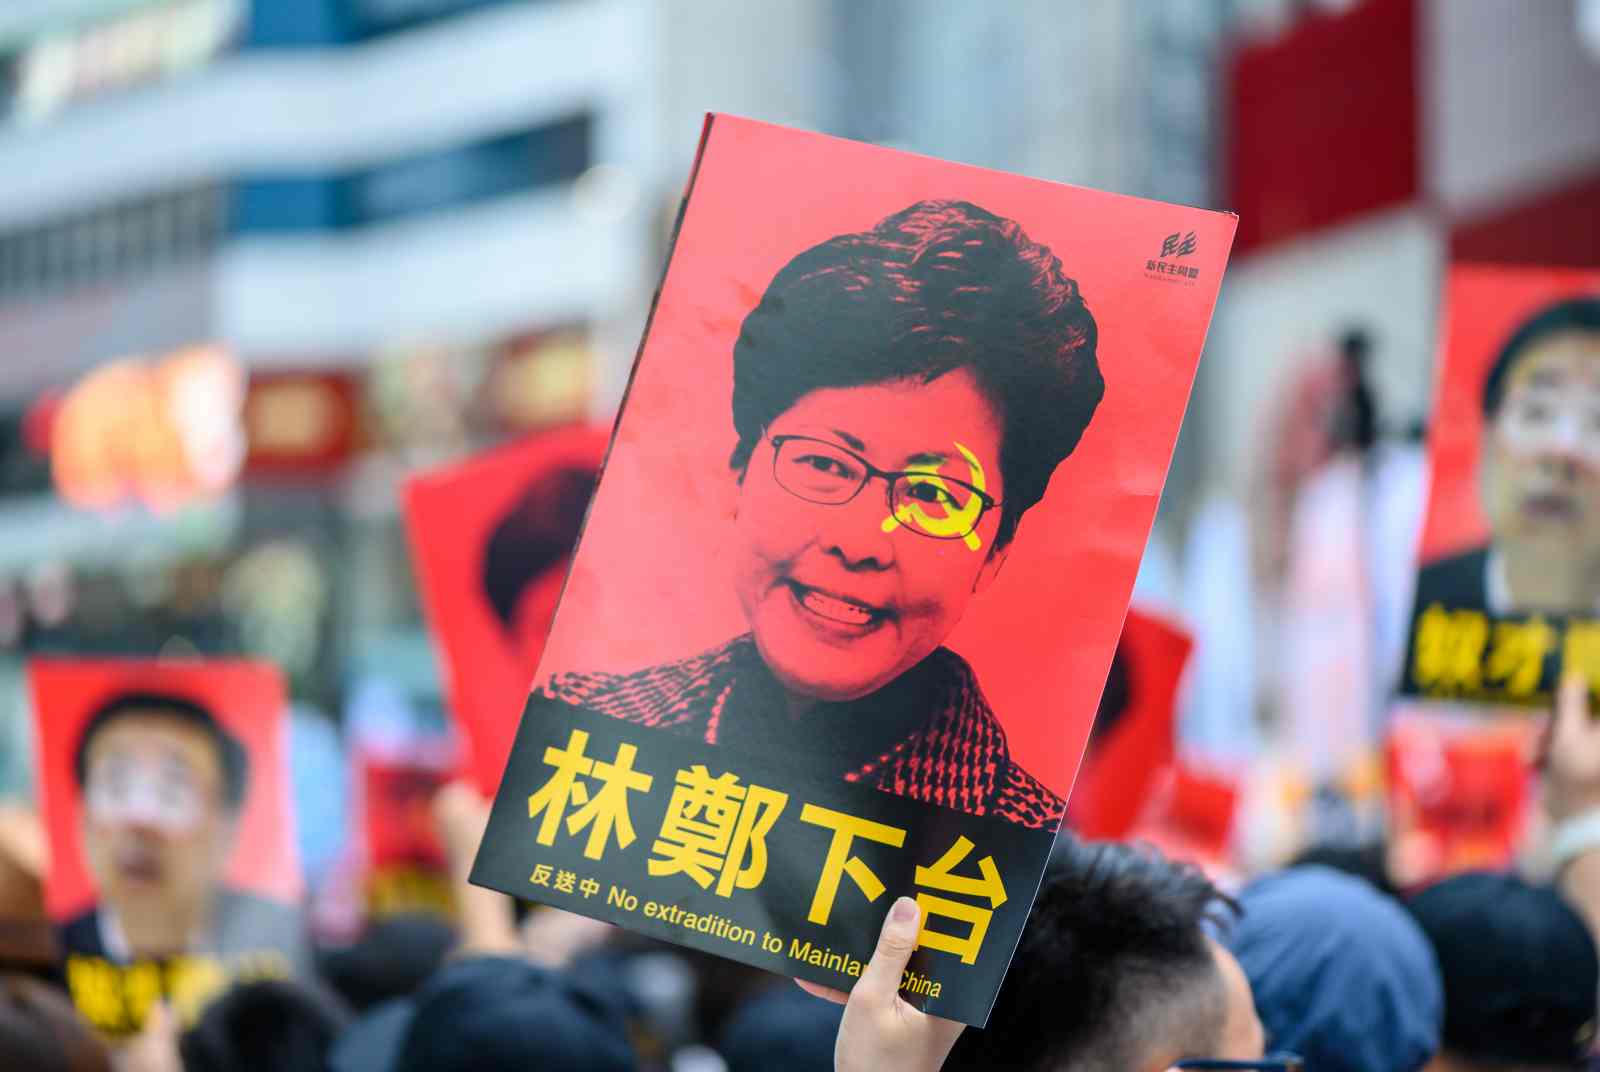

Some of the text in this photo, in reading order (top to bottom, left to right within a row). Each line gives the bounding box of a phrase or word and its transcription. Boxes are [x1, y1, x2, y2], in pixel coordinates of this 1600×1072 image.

[528, 729, 1008, 965] 林鄭下台
[529, 863, 601, 899] 反送中
[607, 885, 639, 912] No
[643, 901, 757, 946] extradition
[761, 930, 783, 953] to
[788, 938, 872, 977] Mainla
